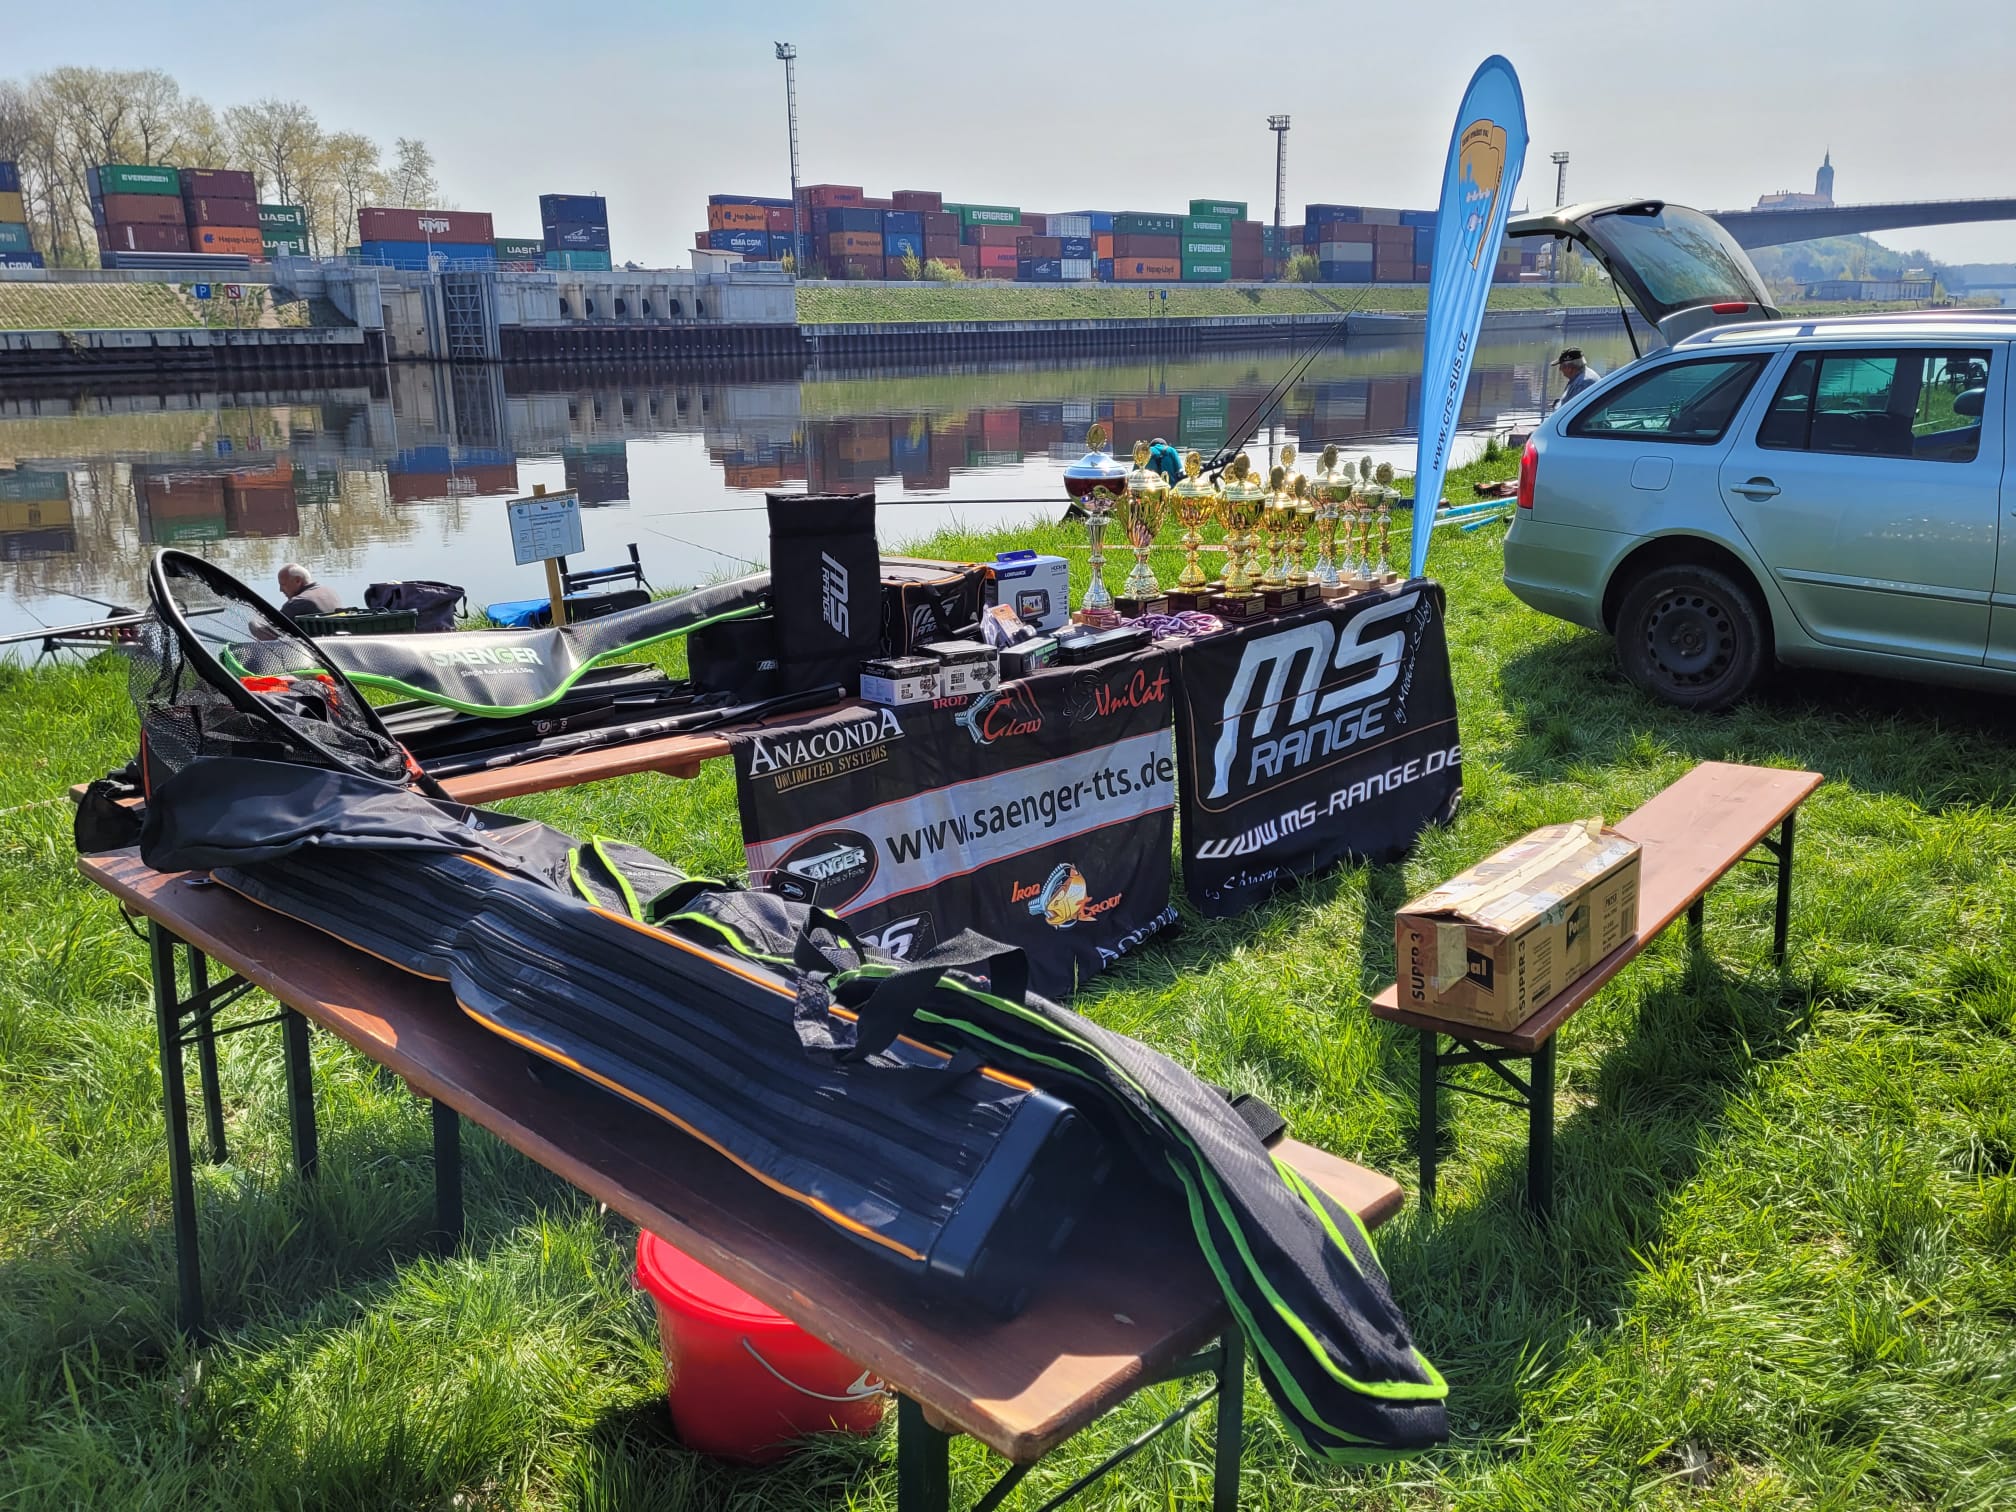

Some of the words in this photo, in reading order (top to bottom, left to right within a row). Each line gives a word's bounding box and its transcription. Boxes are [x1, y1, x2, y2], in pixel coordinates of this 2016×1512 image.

[121, 174, 169, 183] EVERGREEN
[258, 213, 295, 222] UASC
[972, 210, 1014, 221] EVERGREEN
[1213, 206, 1239, 214] EVERGREEN
[418, 219, 450, 234] HMM
[1193, 222, 1222, 230] EVERGREEN
[1188, 244, 1226, 253] EVERGREEN
[1193, 265, 1222, 273] EVERGREEN
[1432, 329, 1469, 472] www.crs-sus.cz
[430, 647, 545, 667] SAENGER
[1096, 667, 1170, 716] UniCat
[1207, 590, 1421, 799] MS
[1248, 698, 1391, 786] RANGE
[774, 761, 834, 790] UNLIMITED
[838, 745, 887, 772] SYSTEMS
[886, 751, 1174, 865] www.saenger-tts.de
[1411, 932, 1424, 943] 3
[1518, 940, 1526, 953] 3
[1411, 946, 1426, 1001] SUPER
[1518, 957, 1526, 1011] SUPER
